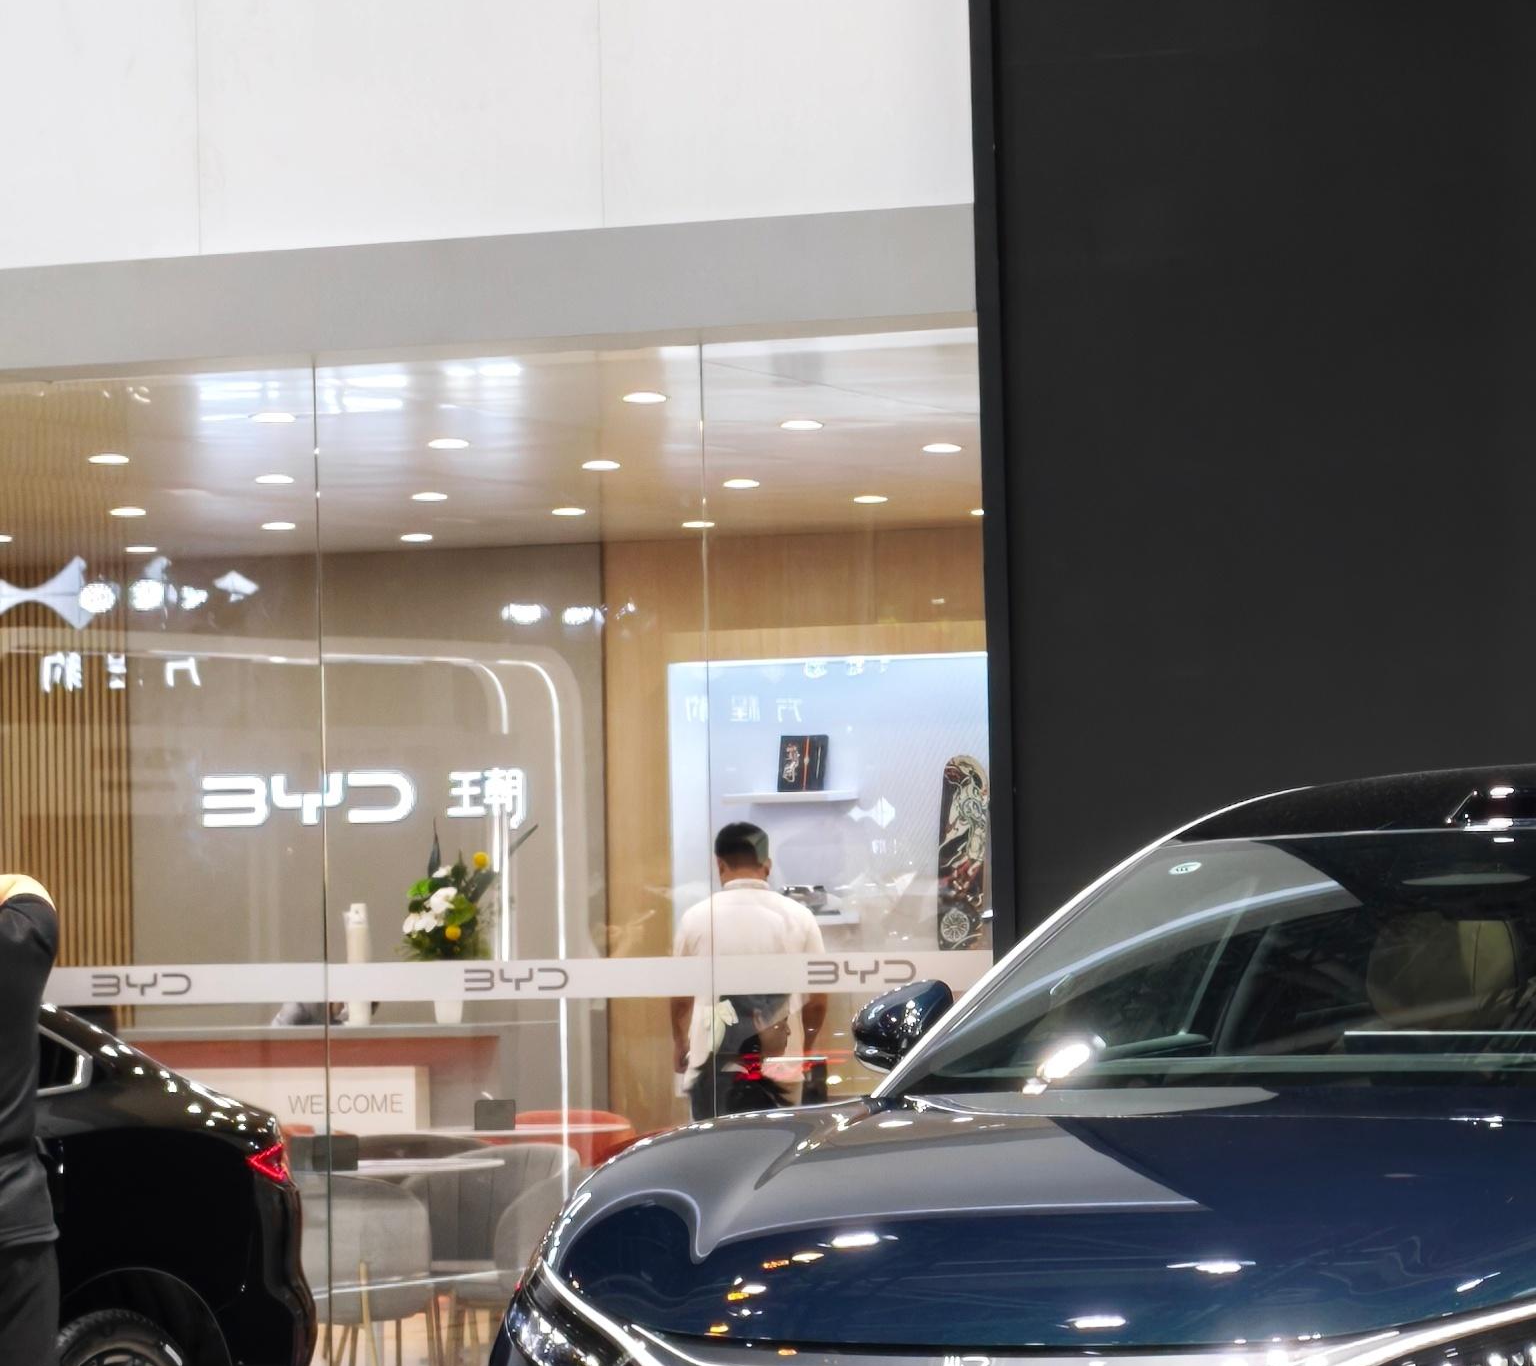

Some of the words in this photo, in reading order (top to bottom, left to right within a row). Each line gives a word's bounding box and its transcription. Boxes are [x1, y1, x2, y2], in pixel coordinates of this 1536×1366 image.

[201, 773, 415, 828] BYD
[91, 973, 192, 996] BYD
[463, 968, 569, 992] BYD
[807, 960, 917, 985] BYD
